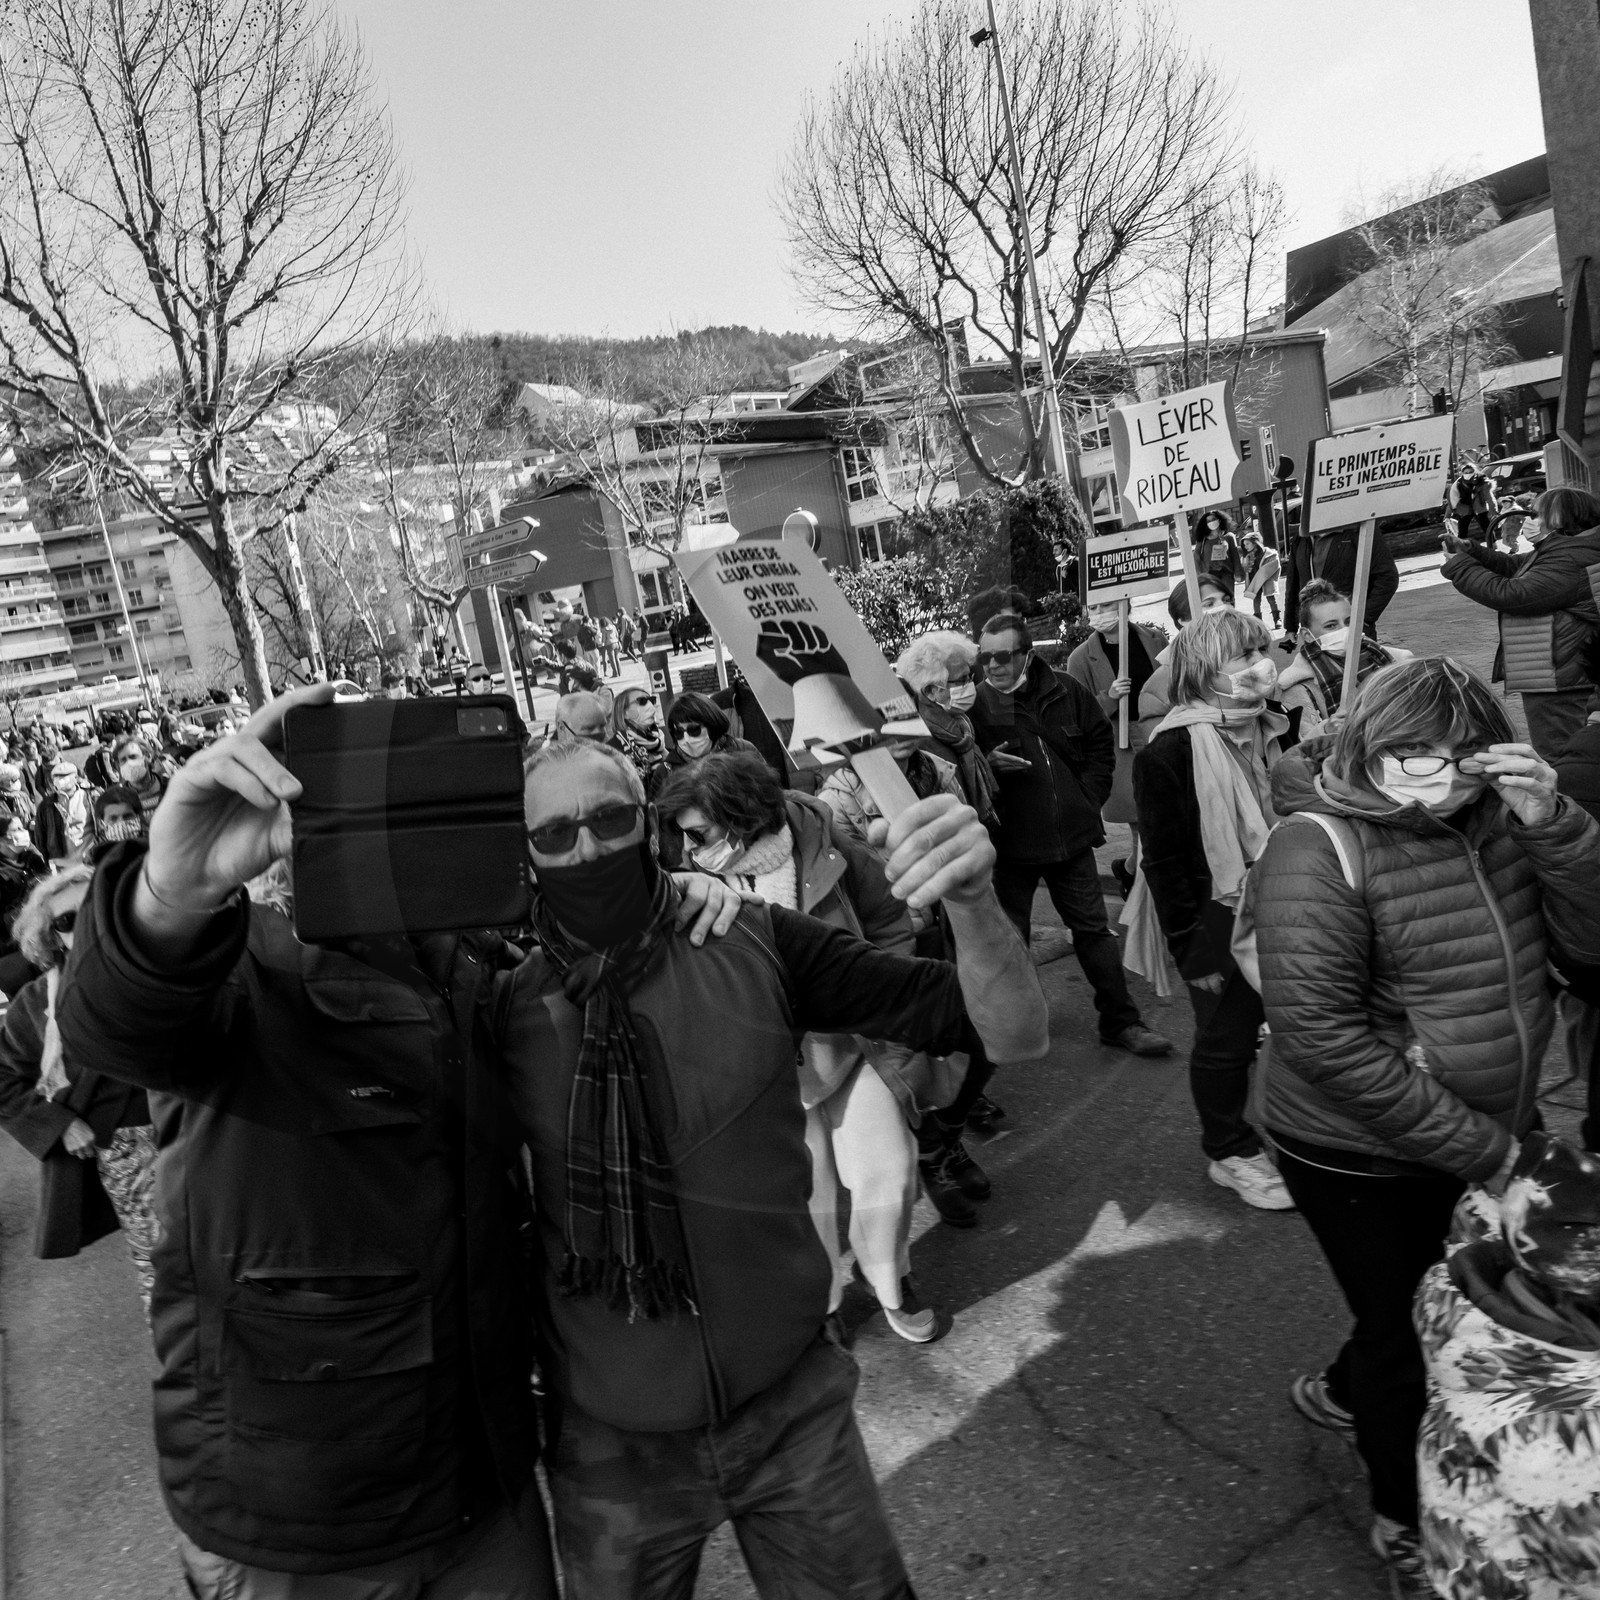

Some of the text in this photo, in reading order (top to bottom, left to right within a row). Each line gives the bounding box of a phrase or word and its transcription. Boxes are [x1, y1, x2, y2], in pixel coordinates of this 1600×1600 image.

[1137, 398, 1218, 446] LEVER
[1164, 440, 1190, 467] DE
[1318, 442, 1417, 476] LE PRINTEMPS
[1329, 454, 1442, 491] EST INEXORABLE
[716, 547, 782, 566] MARRE DE
[1090, 547, 1149, 568] LE PRINTEMPS
[1097, 567, 1112, 578] EST
[1114, 555, 1165, 575] INEXORABLE
[716, 566, 754, 584] LEUR
[743, 582, 800, 601] ON VEUT
[747, 602, 777, 619] DES
